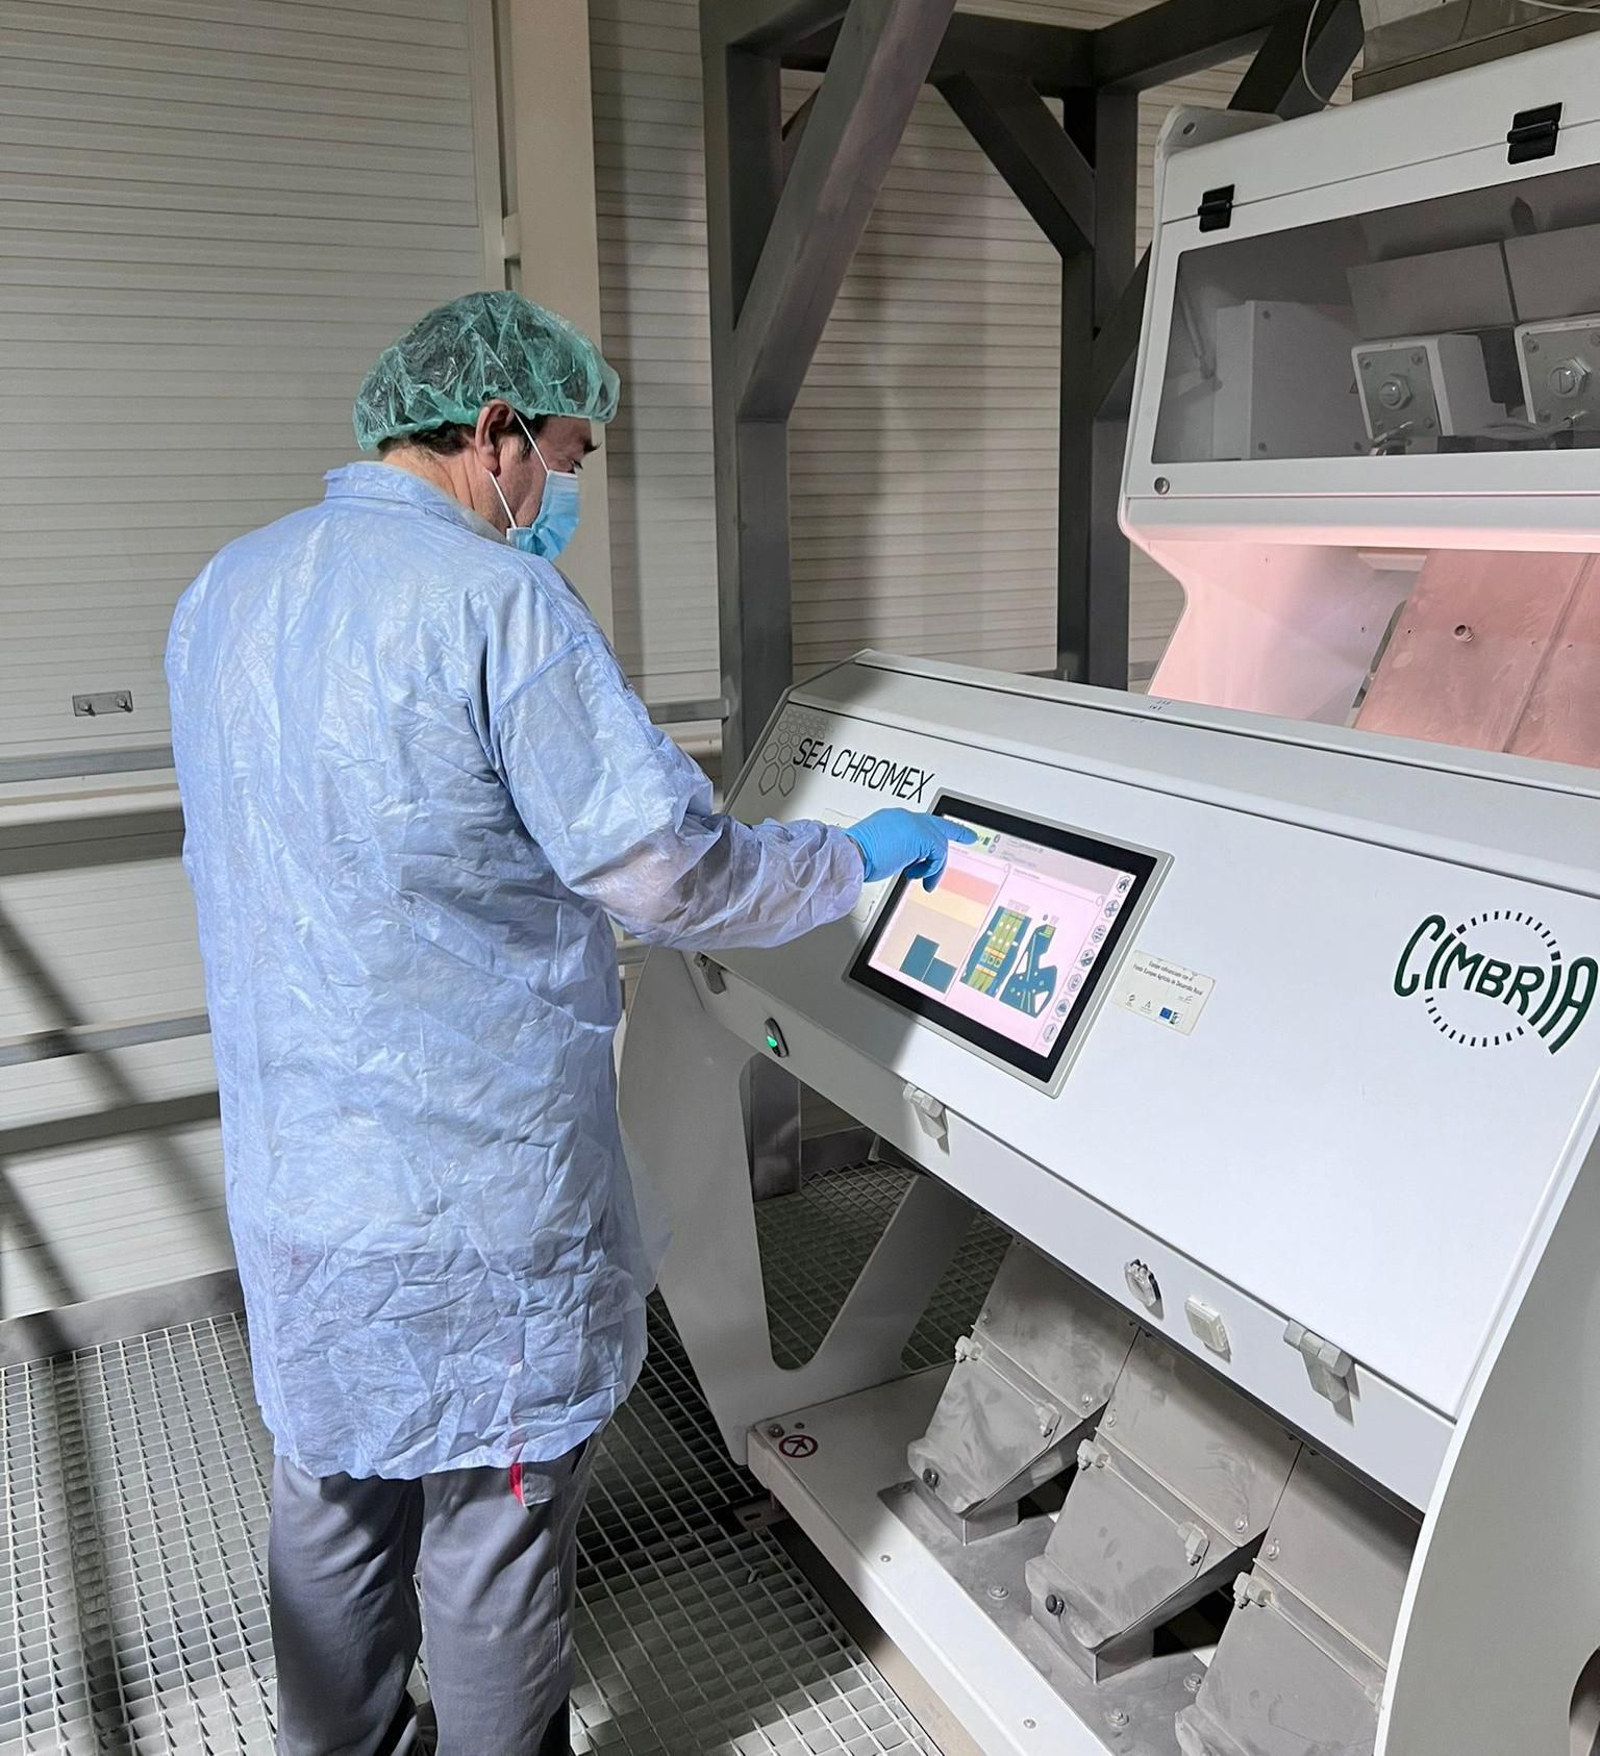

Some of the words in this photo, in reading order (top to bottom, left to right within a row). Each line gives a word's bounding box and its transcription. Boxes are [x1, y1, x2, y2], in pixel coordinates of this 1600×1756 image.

[793, 738, 833, 773] SEA
[831, 749, 935, 803] CHROMEX
[1394, 914, 1599, 1055] CIMBRIA
